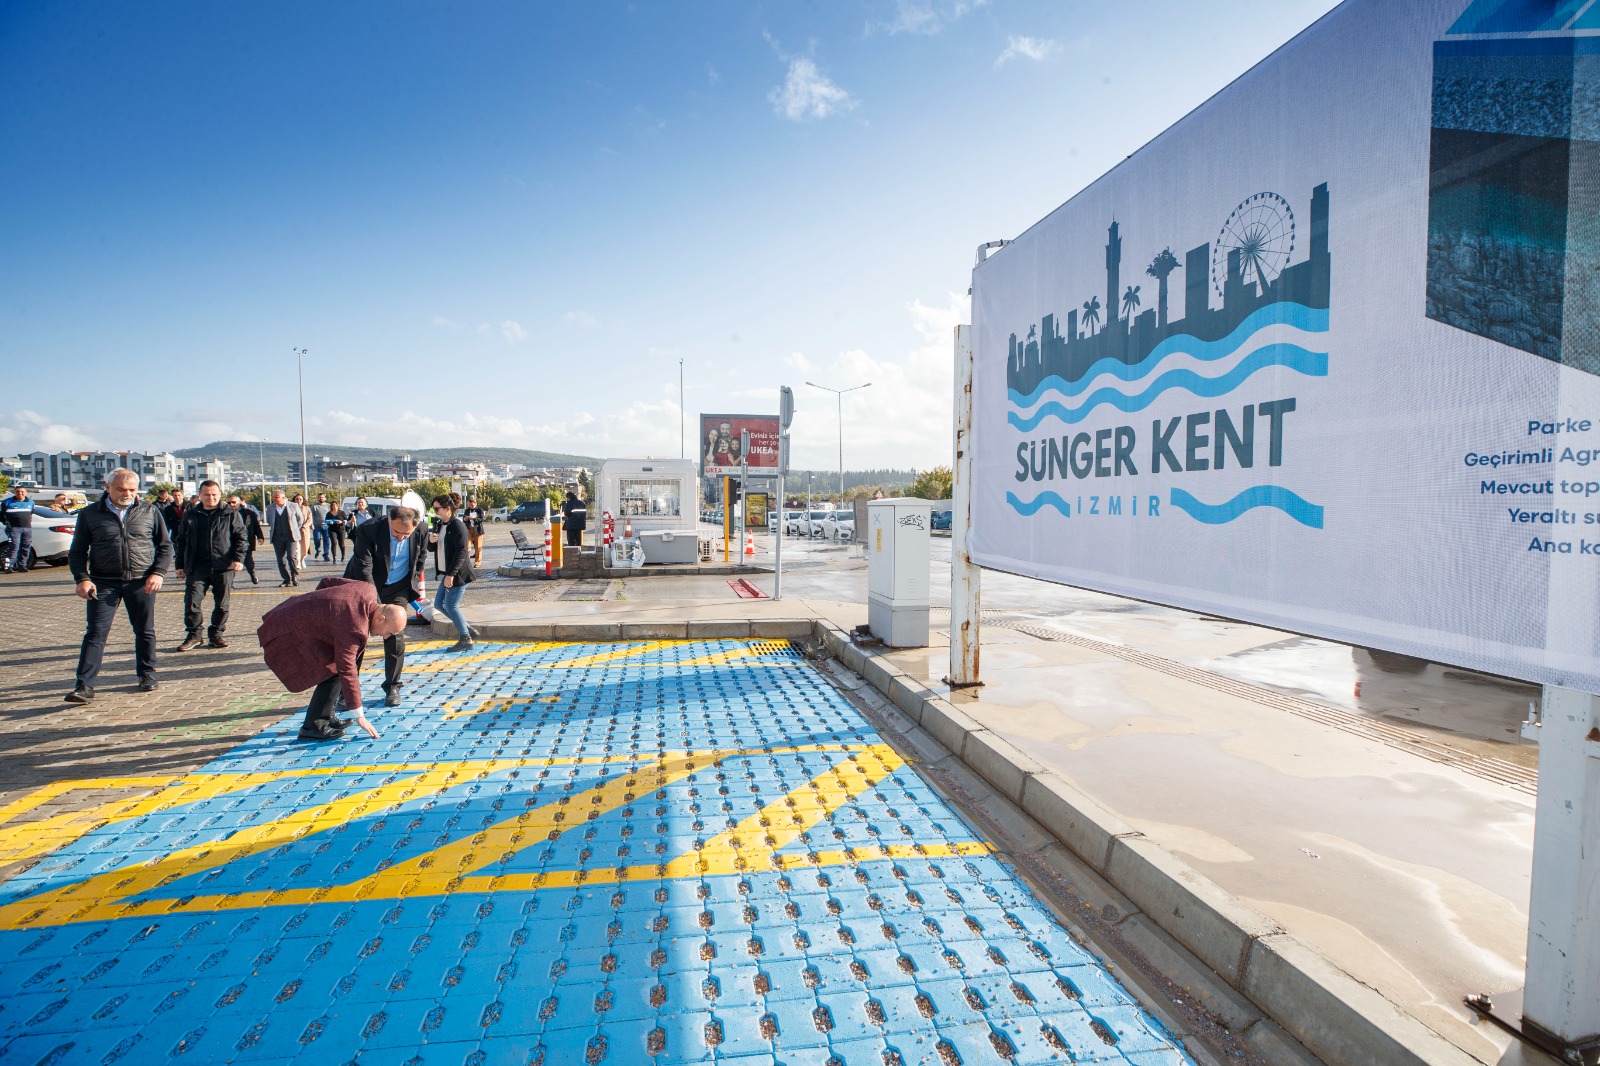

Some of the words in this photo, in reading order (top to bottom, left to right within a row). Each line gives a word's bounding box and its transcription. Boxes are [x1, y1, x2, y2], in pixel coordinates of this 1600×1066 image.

[1528, 418, 1592, 435] Parke
[1015, 425, 1138, 482] SÜNGER
[1151, 397, 1296, 474] KENT
[1464, 448, 1553, 468] Geçirimli
[1480, 480, 1554, 494] Mevcut
[1560, 480, 1600, 497] top
[1077, 495, 1160, 516] İZMİR
[1508, 508, 1576, 524] Yeraltı
[1528, 537, 1572, 554] Ana
